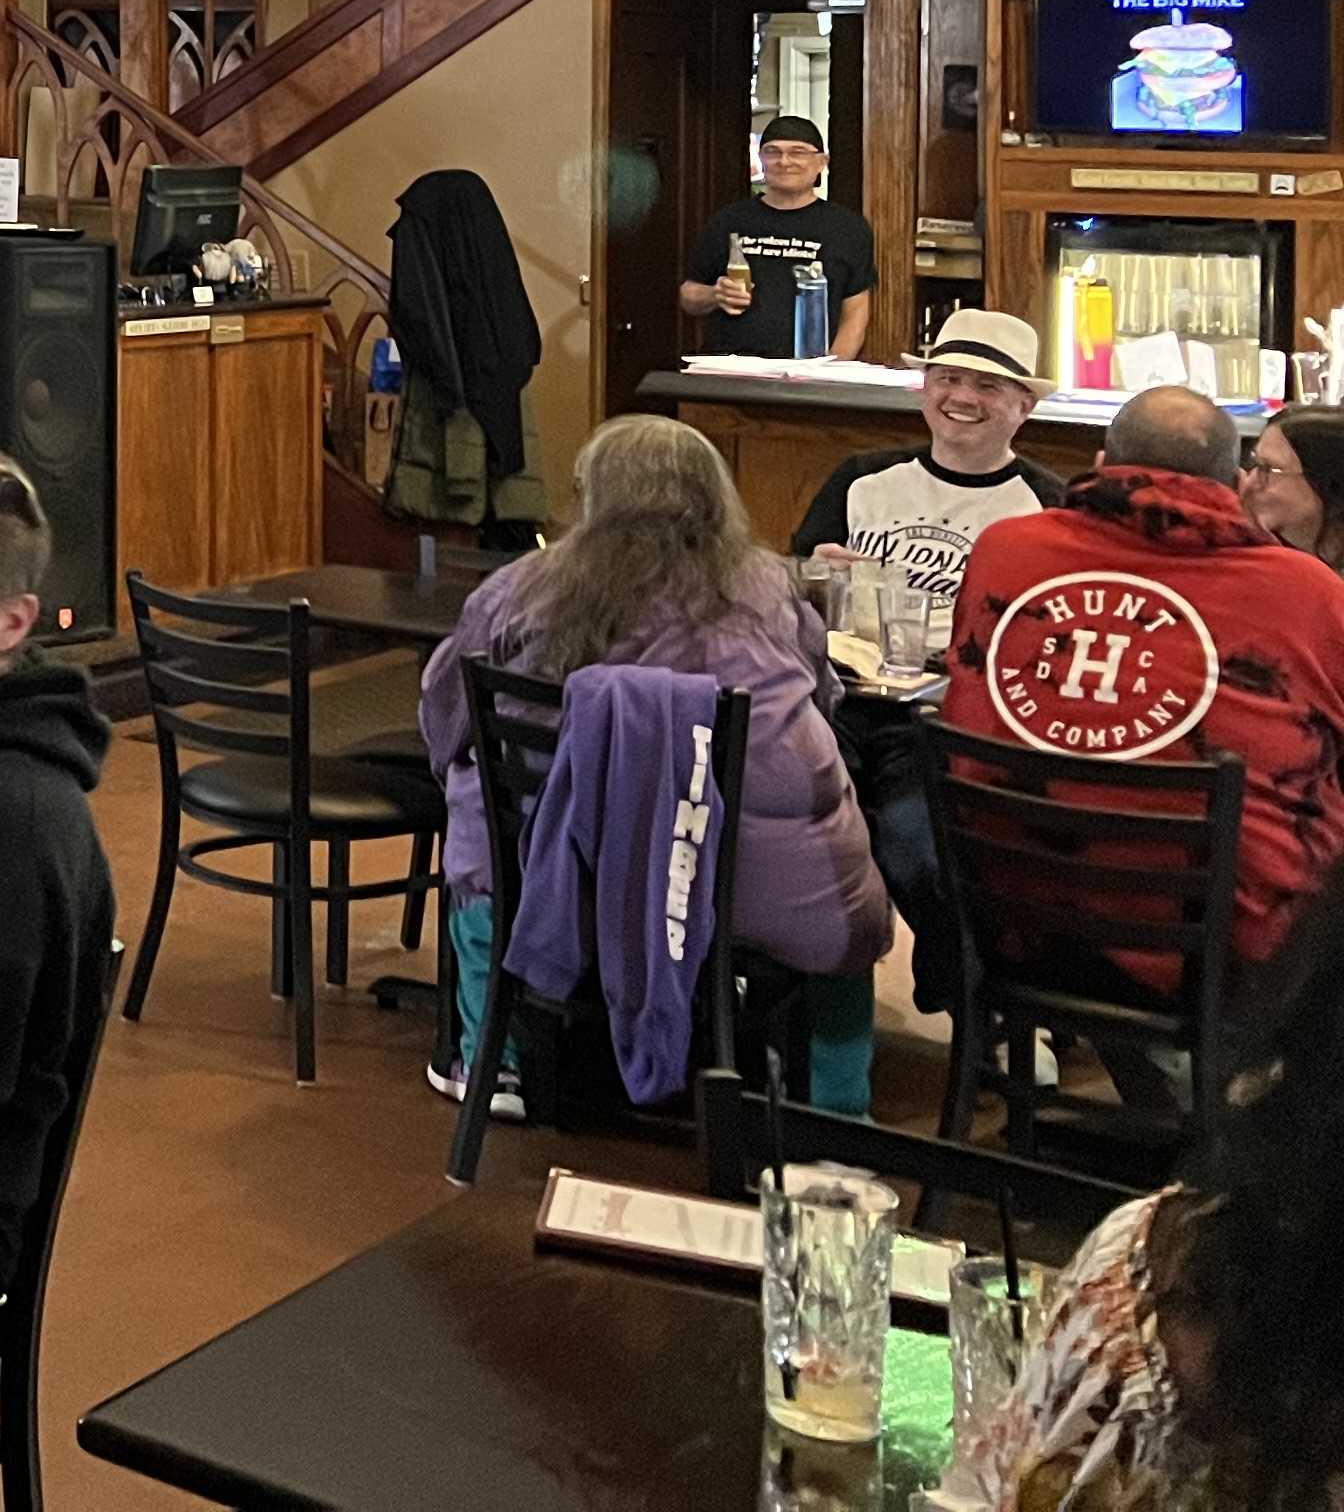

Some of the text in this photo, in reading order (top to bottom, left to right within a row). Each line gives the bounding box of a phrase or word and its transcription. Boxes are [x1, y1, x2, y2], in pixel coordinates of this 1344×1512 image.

[1045, 589, 1177, 632] HUNT
[1002, 667, 1037, 717] AND
[1059, 628, 1131, 704] H
[1046, 689, 1186, 748] COMPANY
